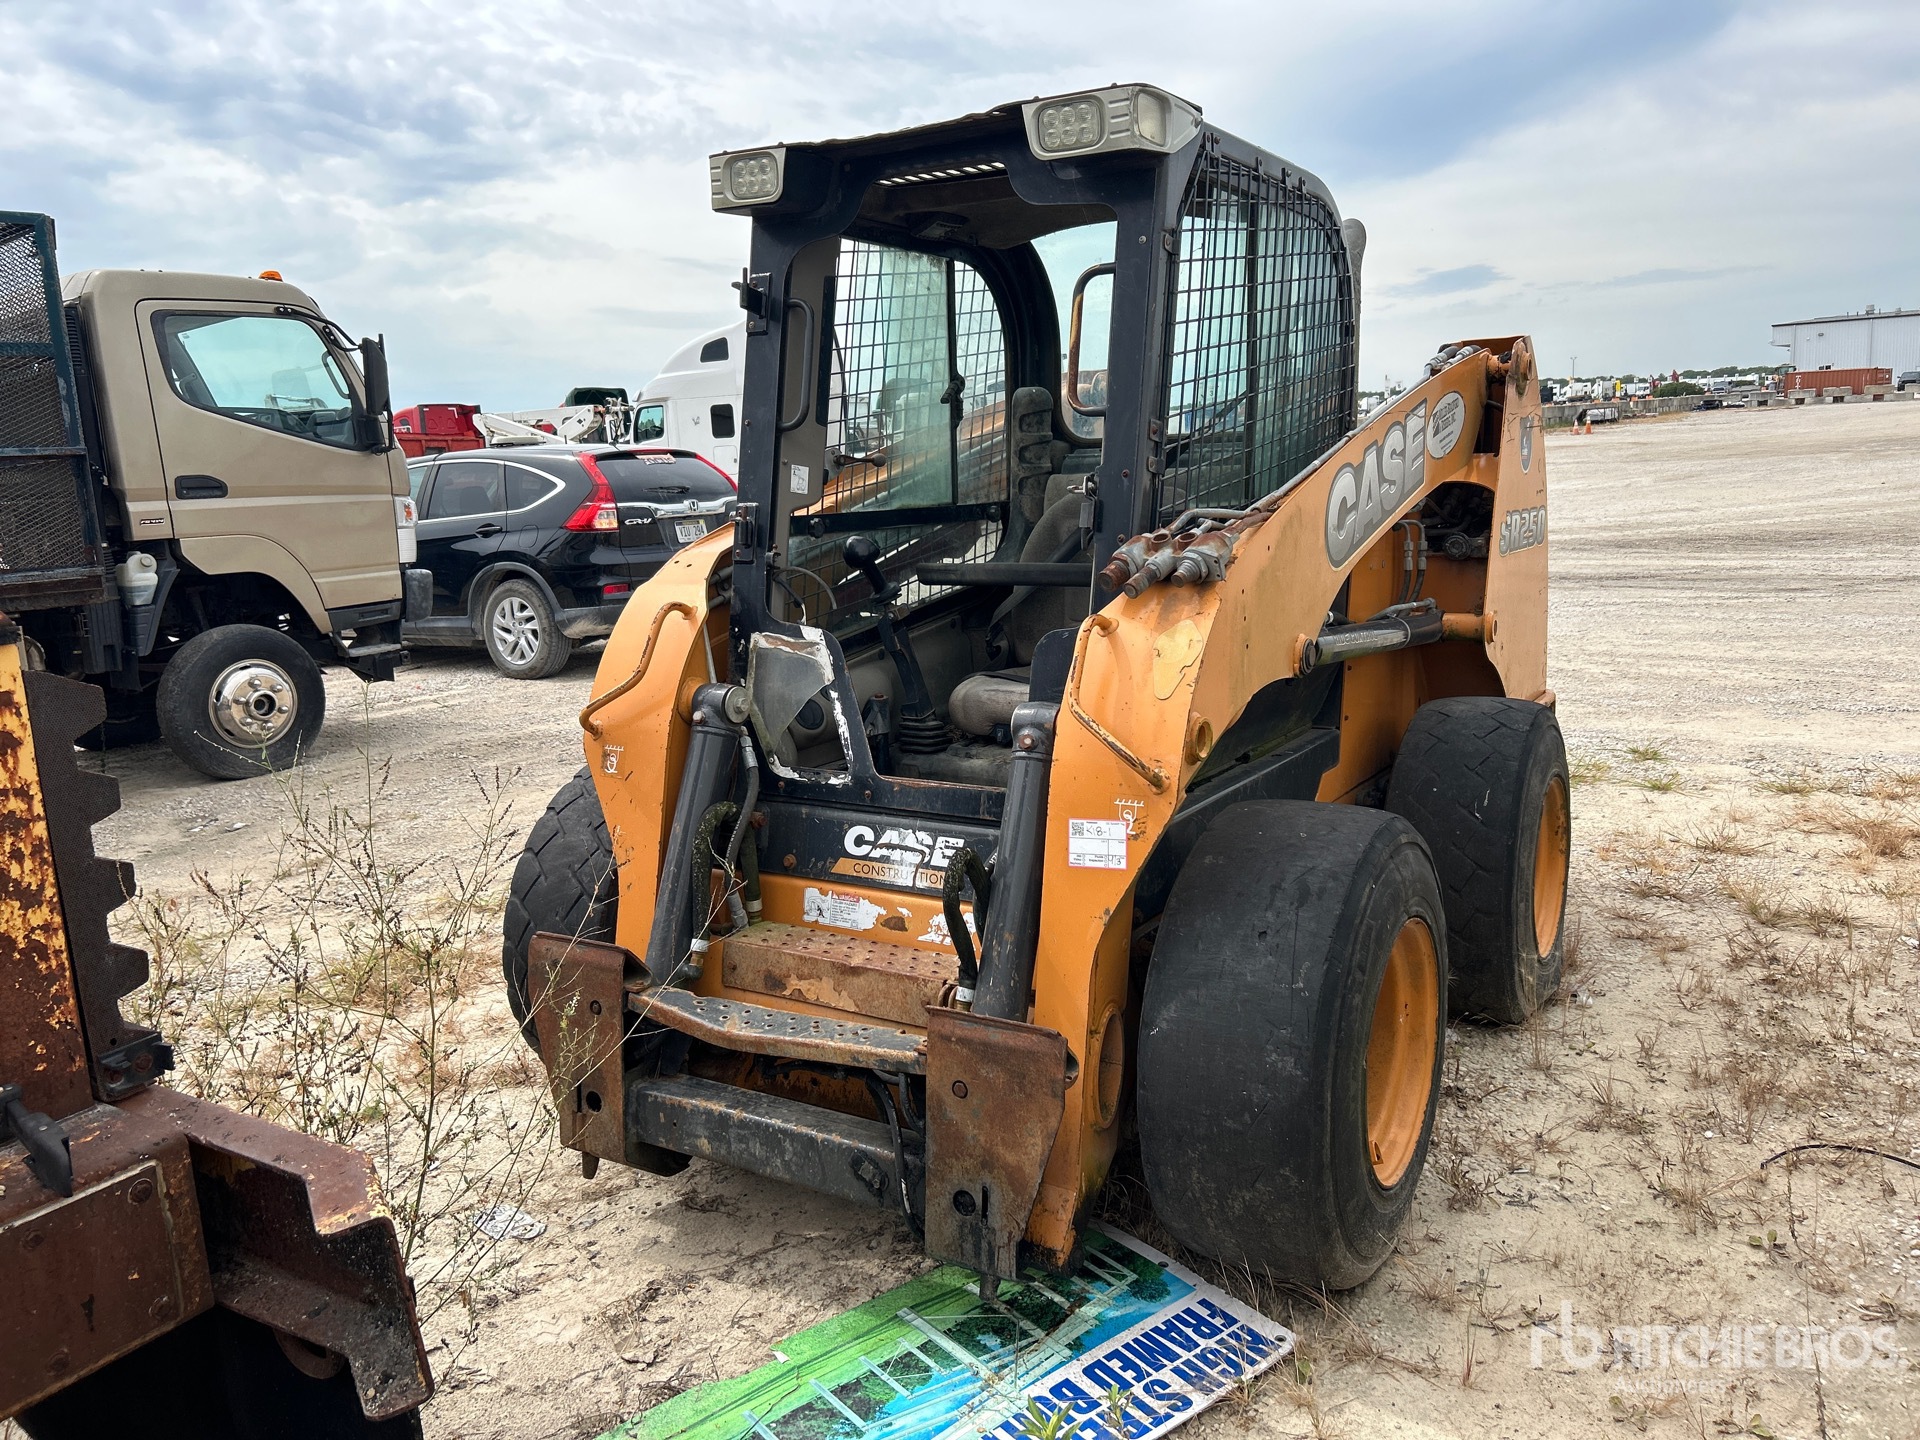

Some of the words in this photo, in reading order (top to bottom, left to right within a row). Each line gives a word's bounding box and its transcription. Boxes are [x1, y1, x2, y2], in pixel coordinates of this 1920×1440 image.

[1327, 400, 1426, 569] CASE
[1500, 505, 1546, 556] SR250
[844, 825, 965, 868] CASE
[1082, 1298, 1241, 1393] FRAMED
[1170, 1324, 1282, 1395] HIGH
[981, 1378, 1102, 1440] BUIL
[1056, 1379, 1193, 1440] STRE
